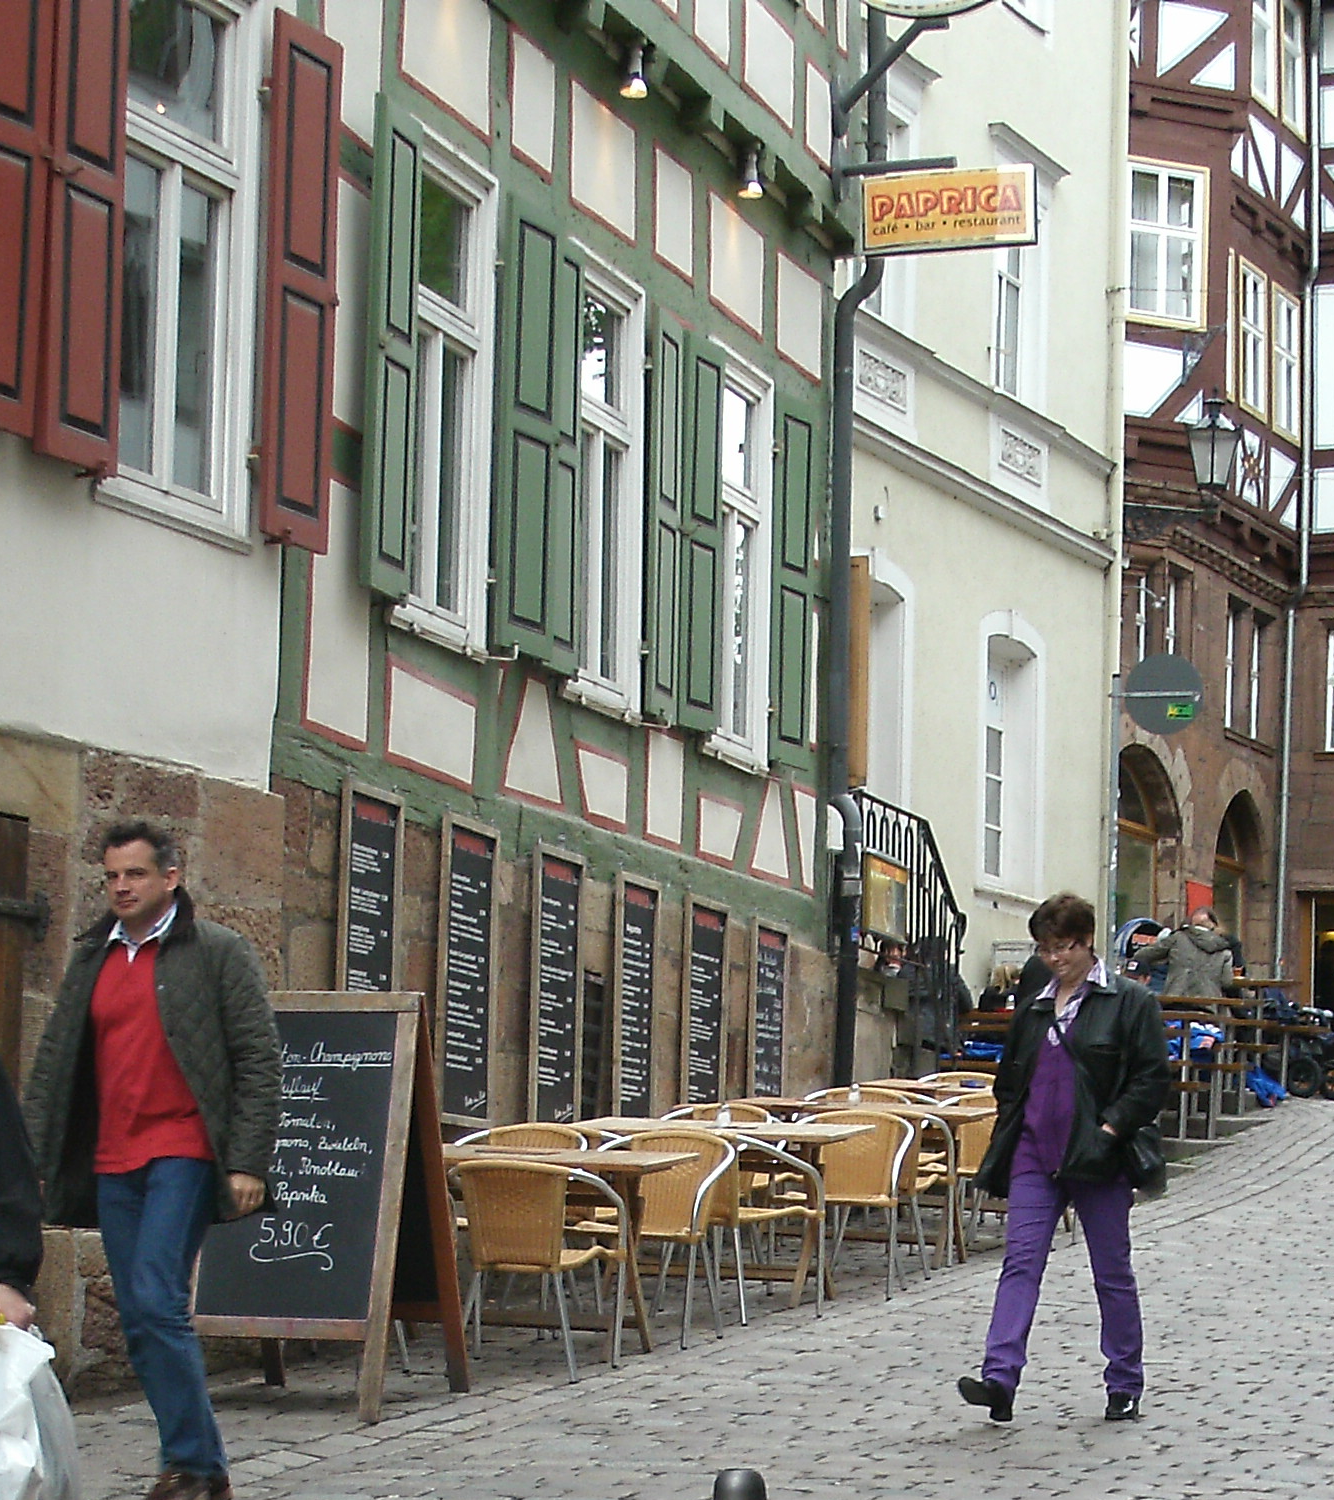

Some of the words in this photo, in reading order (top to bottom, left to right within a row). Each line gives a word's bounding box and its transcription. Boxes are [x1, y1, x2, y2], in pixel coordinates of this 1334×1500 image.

[871, 184, 1022, 222] PAPRICA
[872, 220, 898, 236] café
[915, 219, 935, 231] bar
[953, 214, 1021, 229] restaurant
[274, 1180, 328, 1209] Paprika
[259, 1217, 309, 1248] 5,90
[312, 1222, 334, 1249] €
